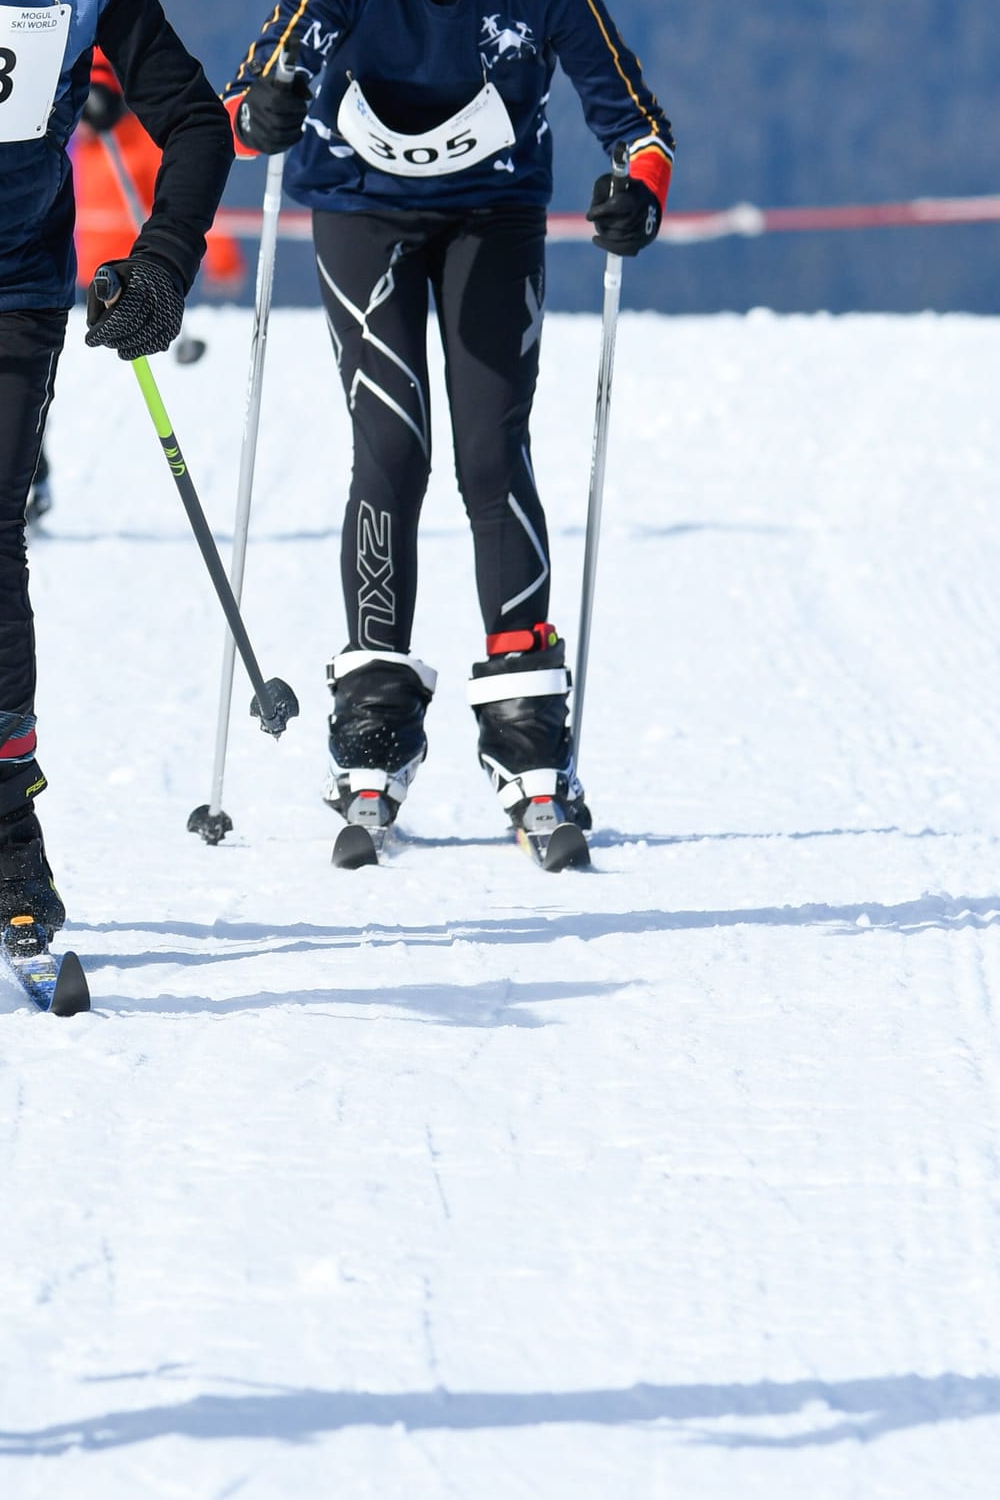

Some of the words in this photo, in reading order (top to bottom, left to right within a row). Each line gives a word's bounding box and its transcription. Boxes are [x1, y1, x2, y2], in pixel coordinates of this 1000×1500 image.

[21, 11, 52, 20] MOGUL
[10, 20, 26, 29] SKI
[27, 19, 58, 29] WORLD
[368, 129, 477, 164] 305
